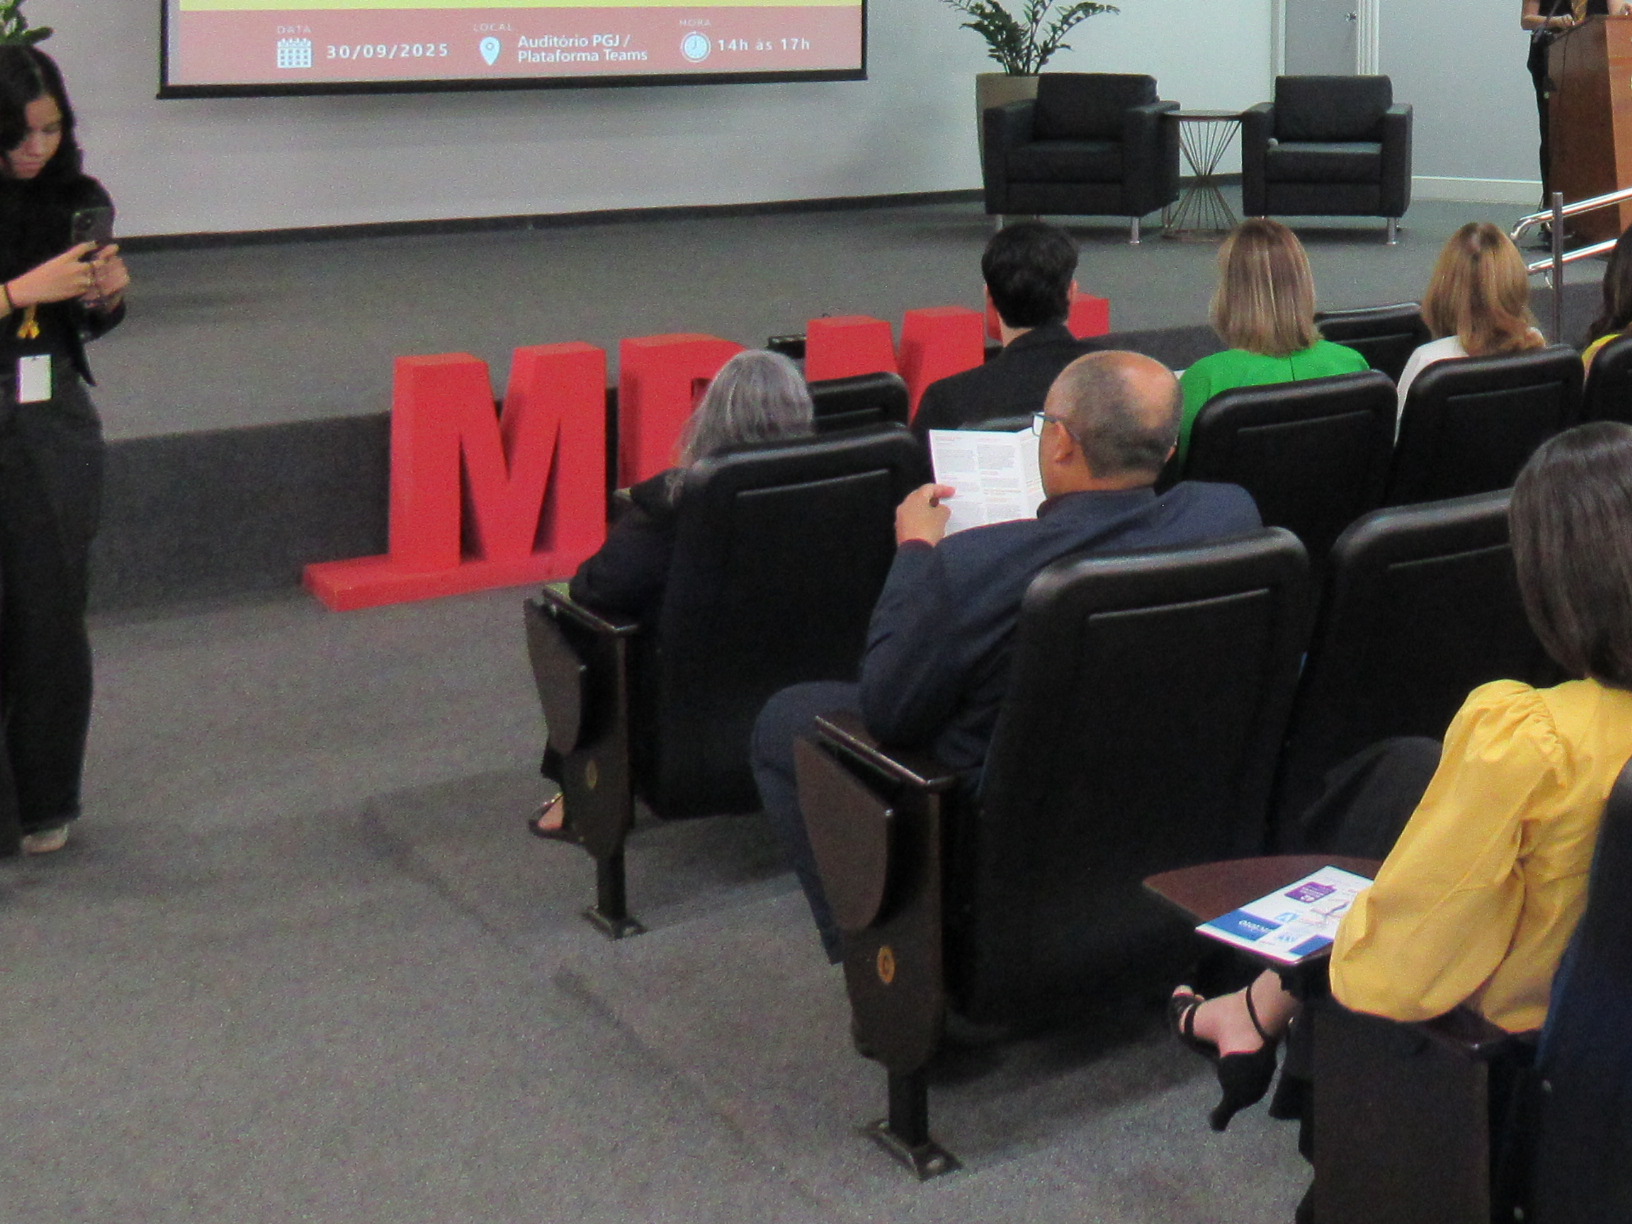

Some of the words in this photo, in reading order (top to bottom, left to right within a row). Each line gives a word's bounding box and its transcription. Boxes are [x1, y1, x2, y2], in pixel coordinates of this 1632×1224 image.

[277, 25, 312, 34] DATA
[473, 23, 513, 32] LOCAL
[679, 19, 712, 27] HORA
[518, 35, 589, 48] Auditório
[592, 34, 620, 47] PGJ
[718, 39, 749, 52] 14h
[781, 37, 810, 51] 17h
[326, 43, 449, 60] 30/09/2025
[518, 49, 600, 63] Plataforma
[603, 49, 648, 62] Teams
